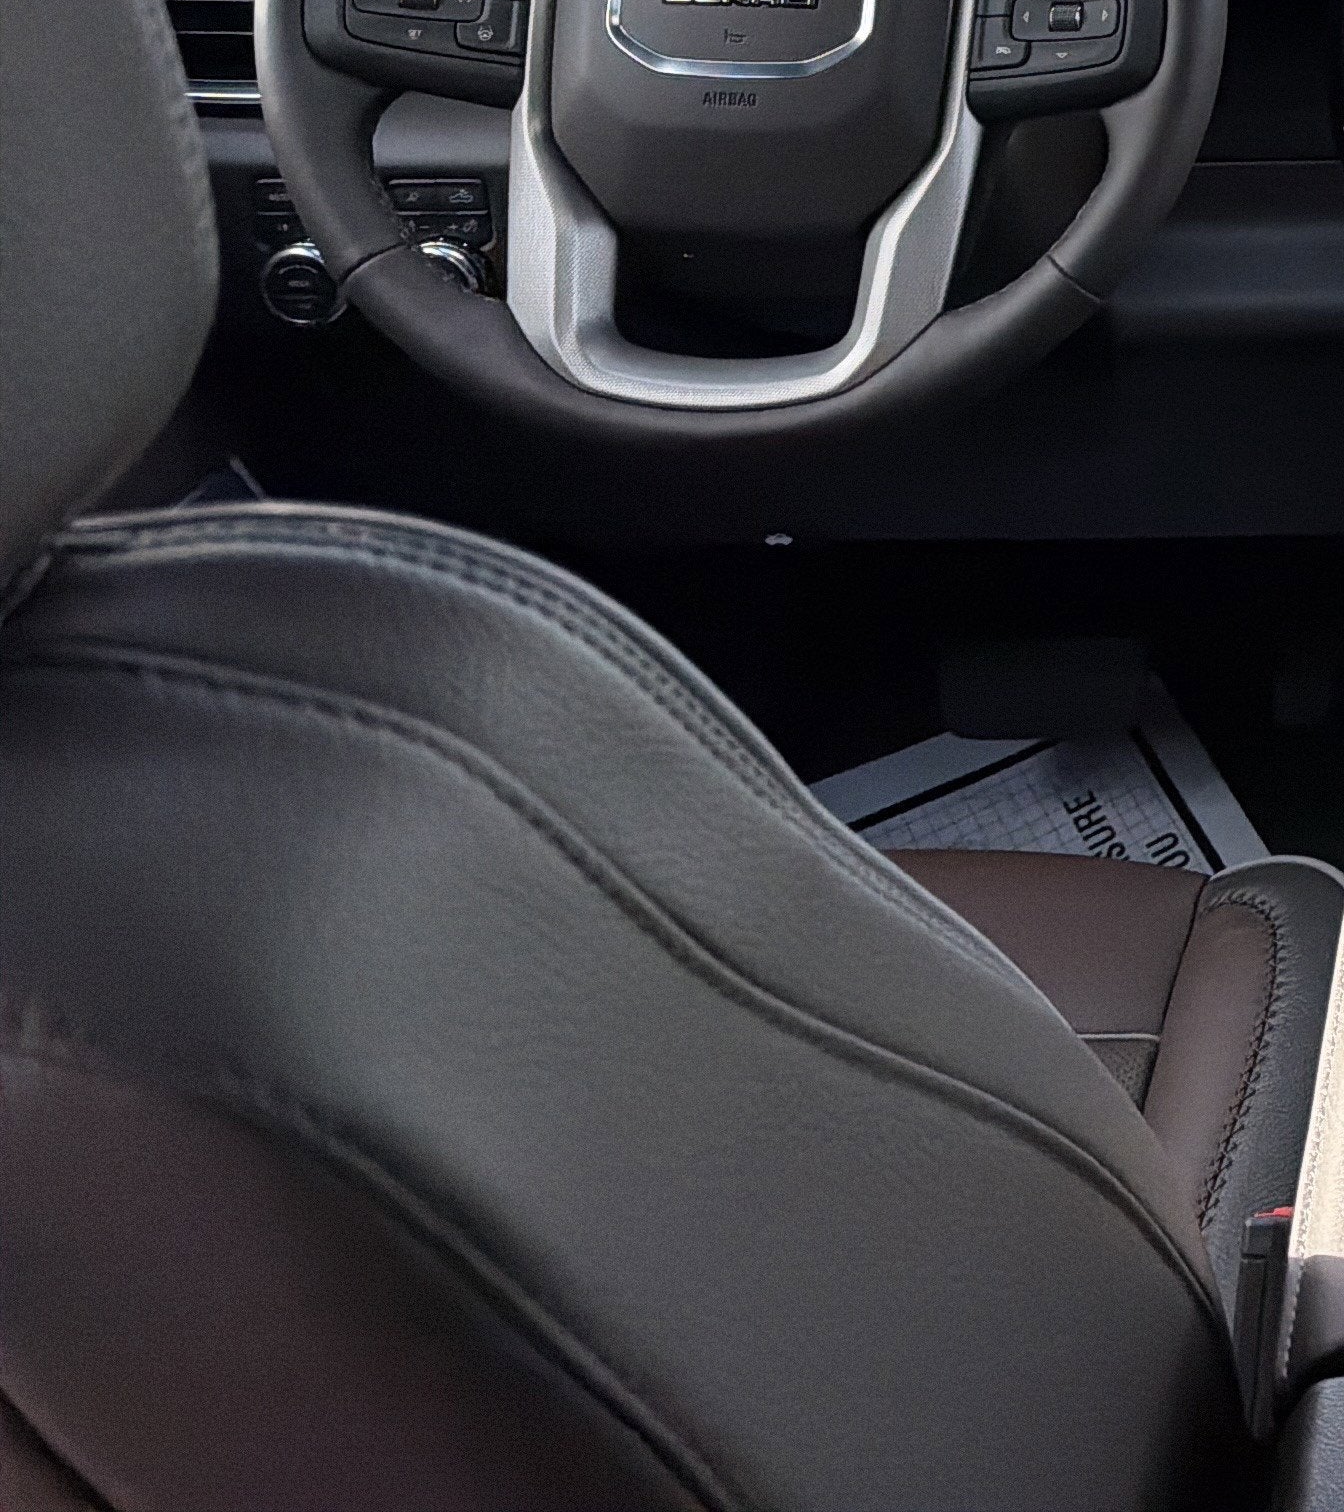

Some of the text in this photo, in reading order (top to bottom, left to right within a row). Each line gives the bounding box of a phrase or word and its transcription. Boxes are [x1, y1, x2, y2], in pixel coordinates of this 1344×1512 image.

[702, 91, 757, 107] AIRBAG
[1063, 790, 1128, 859] SURE
[1145, 832, 1190, 868] OU
